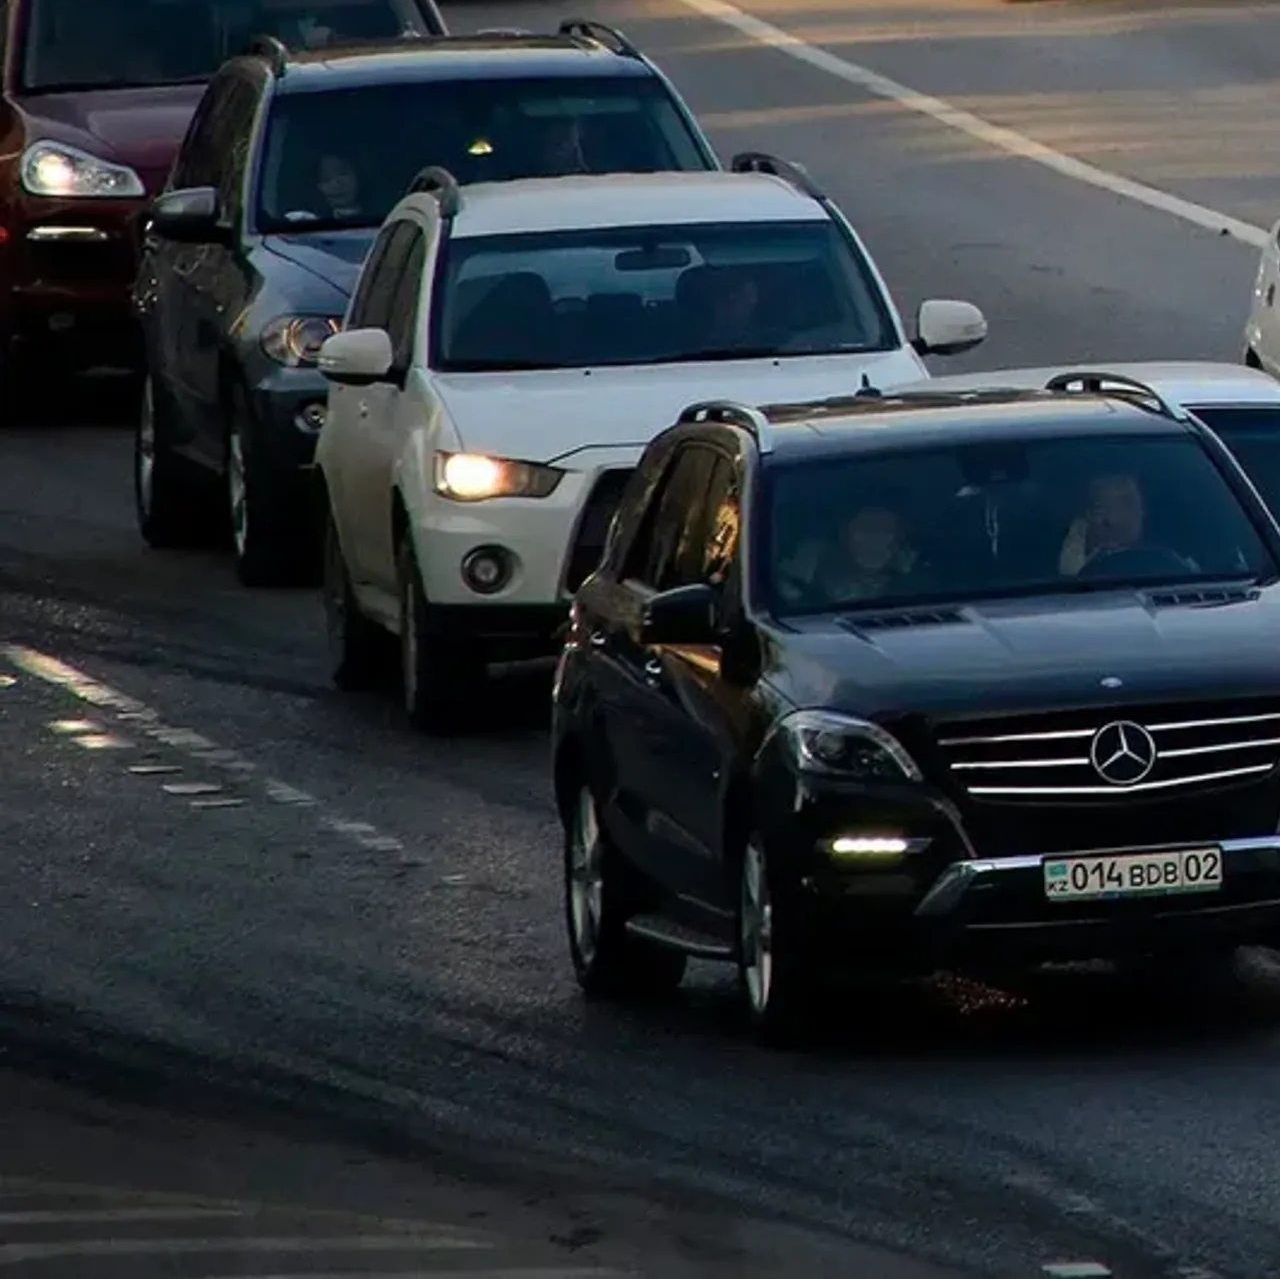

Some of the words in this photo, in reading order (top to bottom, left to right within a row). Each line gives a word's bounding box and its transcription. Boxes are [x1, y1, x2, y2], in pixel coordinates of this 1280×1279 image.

[1071, 861, 1122, 890] 014
[1129, 862, 1178, 887] BDB
[1185, 853, 1218, 882] 02
